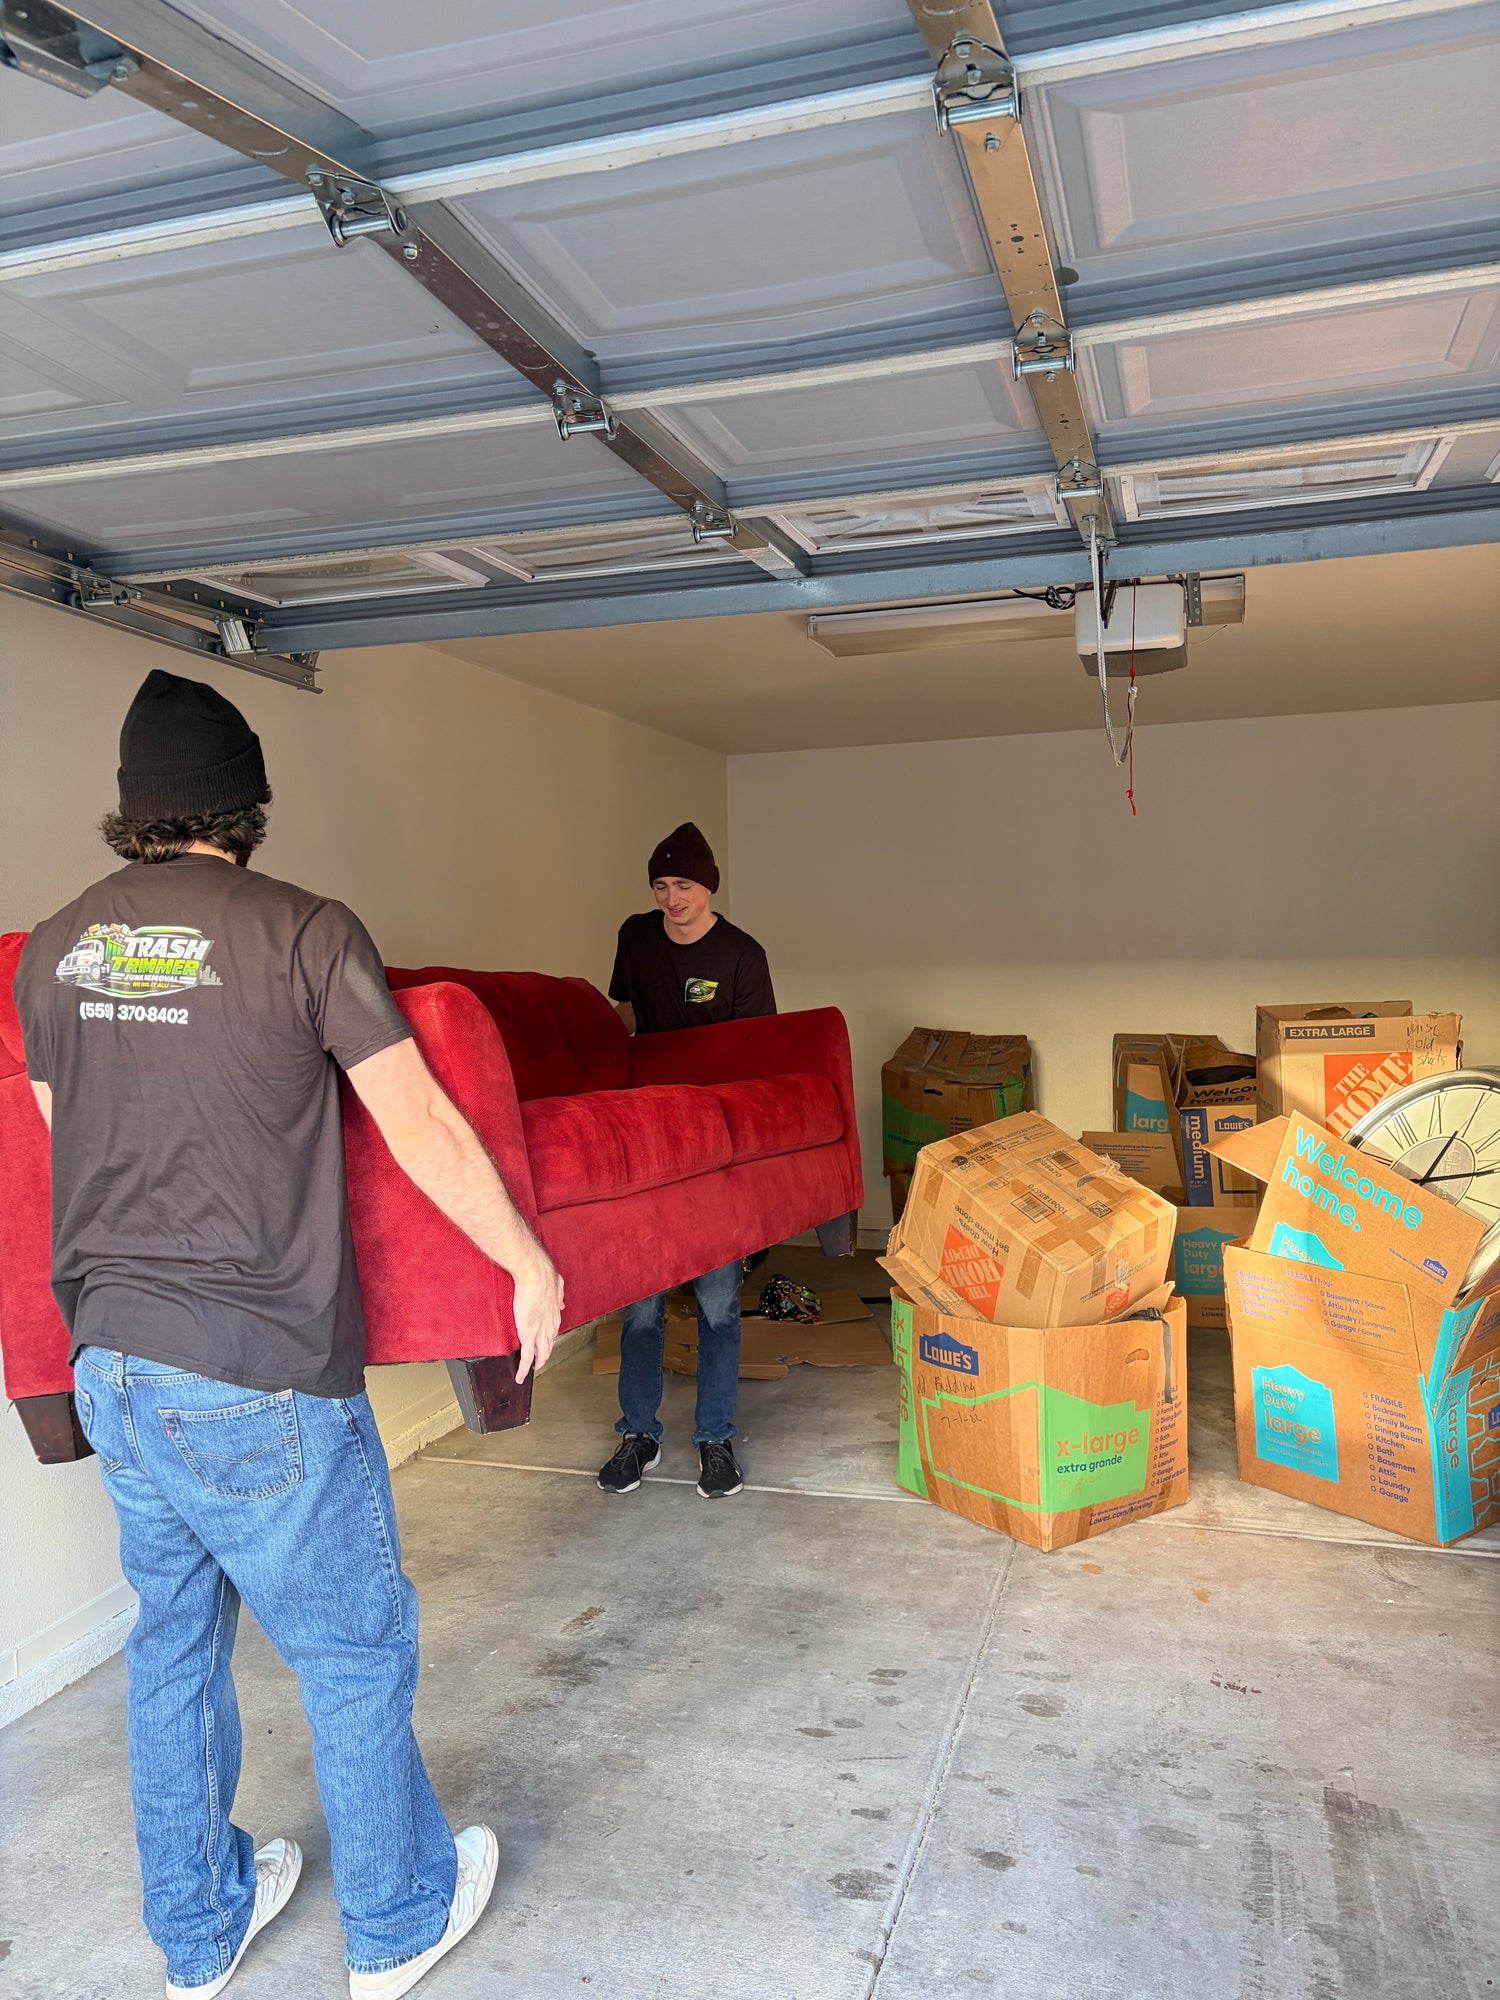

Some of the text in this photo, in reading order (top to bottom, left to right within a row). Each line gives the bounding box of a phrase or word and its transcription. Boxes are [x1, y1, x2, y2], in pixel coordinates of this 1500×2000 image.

[123, 937, 211, 960] TRASH
[117, 1004, 188, 1025] 370-8402
[1290, 1026, 1371, 1038] EXTRA LARGE
[1333, 1062, 1371, 1094] THE
[1189, 1095, 1251, 1105] home.
[1193, 1085, 1257, 1098] Welco
[1325, 1052, 1412, 1137] HOME
[1133, 1113, 1169, 1133] larg
[1218, 1121, 1250, 1131] LOWE'S
[1190, 1115, 1206, 1180] medium
[1293, 1126, 1423, 1231] Welcome
[1281, 1155, 1361, 1233] home.
[954, 1205, 1010, 1253] get more done
[958, 1218, 999, 1257] How doers
[1182, 1239, 1218, 1250] Heavy
[1183, 1249, 1209, 1260] Duty
[942, 1258, 1002, 1288] HOME
[965, 1285, 992, 1300] THE
[1326, 1291, 1360, 1305] Basement
[1328, 1301, 1344, 1311] Attic
[1329, 1310, 1357, 1324] Laundry
[1330, 1320, 1357, 1333] Garage
[924, 1340, 973, 1371] LOWE'S
[1262, 1376, 1304, 1403] Heavy
[1263, 1392, 1295, 1414] Duty
[1370, 1393, 1403, 1409] FRAGILE
[1160, 1405, 1174, 1415] Family
[1371, 1403, 1407, 1420] Bedroom
[1160, 1414, 1173, 1424] Dining
[1160, 1422, 1176, 1432] Kitchen
[1265, 1408, 1321, 1445] large
[1373, 1413, 1423, 1434] Family Room
[1055, 1427, 1140, 1458] x-large
[1160, 1433, 1170, 1441] Bath
[1374, 1424, 1423, 1445] Dining Room
[1375, 1434, 1406, 1450] Kitchen
[1445, 1401, 1461, 1470] large
[1159, 1438, 1179, 1450] Basement
[1376, 1445, 1395, 1457] Bath
[1056, 1454, 1123, 1475] extra grande
[1157, 1466, 1174, 1476] Garage
[1158, 1457, 1175, 1468] Laundry
[1377, 1455, 1417, 1474] Basement
[1378, 1466, 1397, 1478] Attic
[1378, 1476, 1411, 1494] Laundry
[1379, 1487, 1409, 1503] Garage
[1088, 1501, 1154, 1527] Lowes.com/Moving
